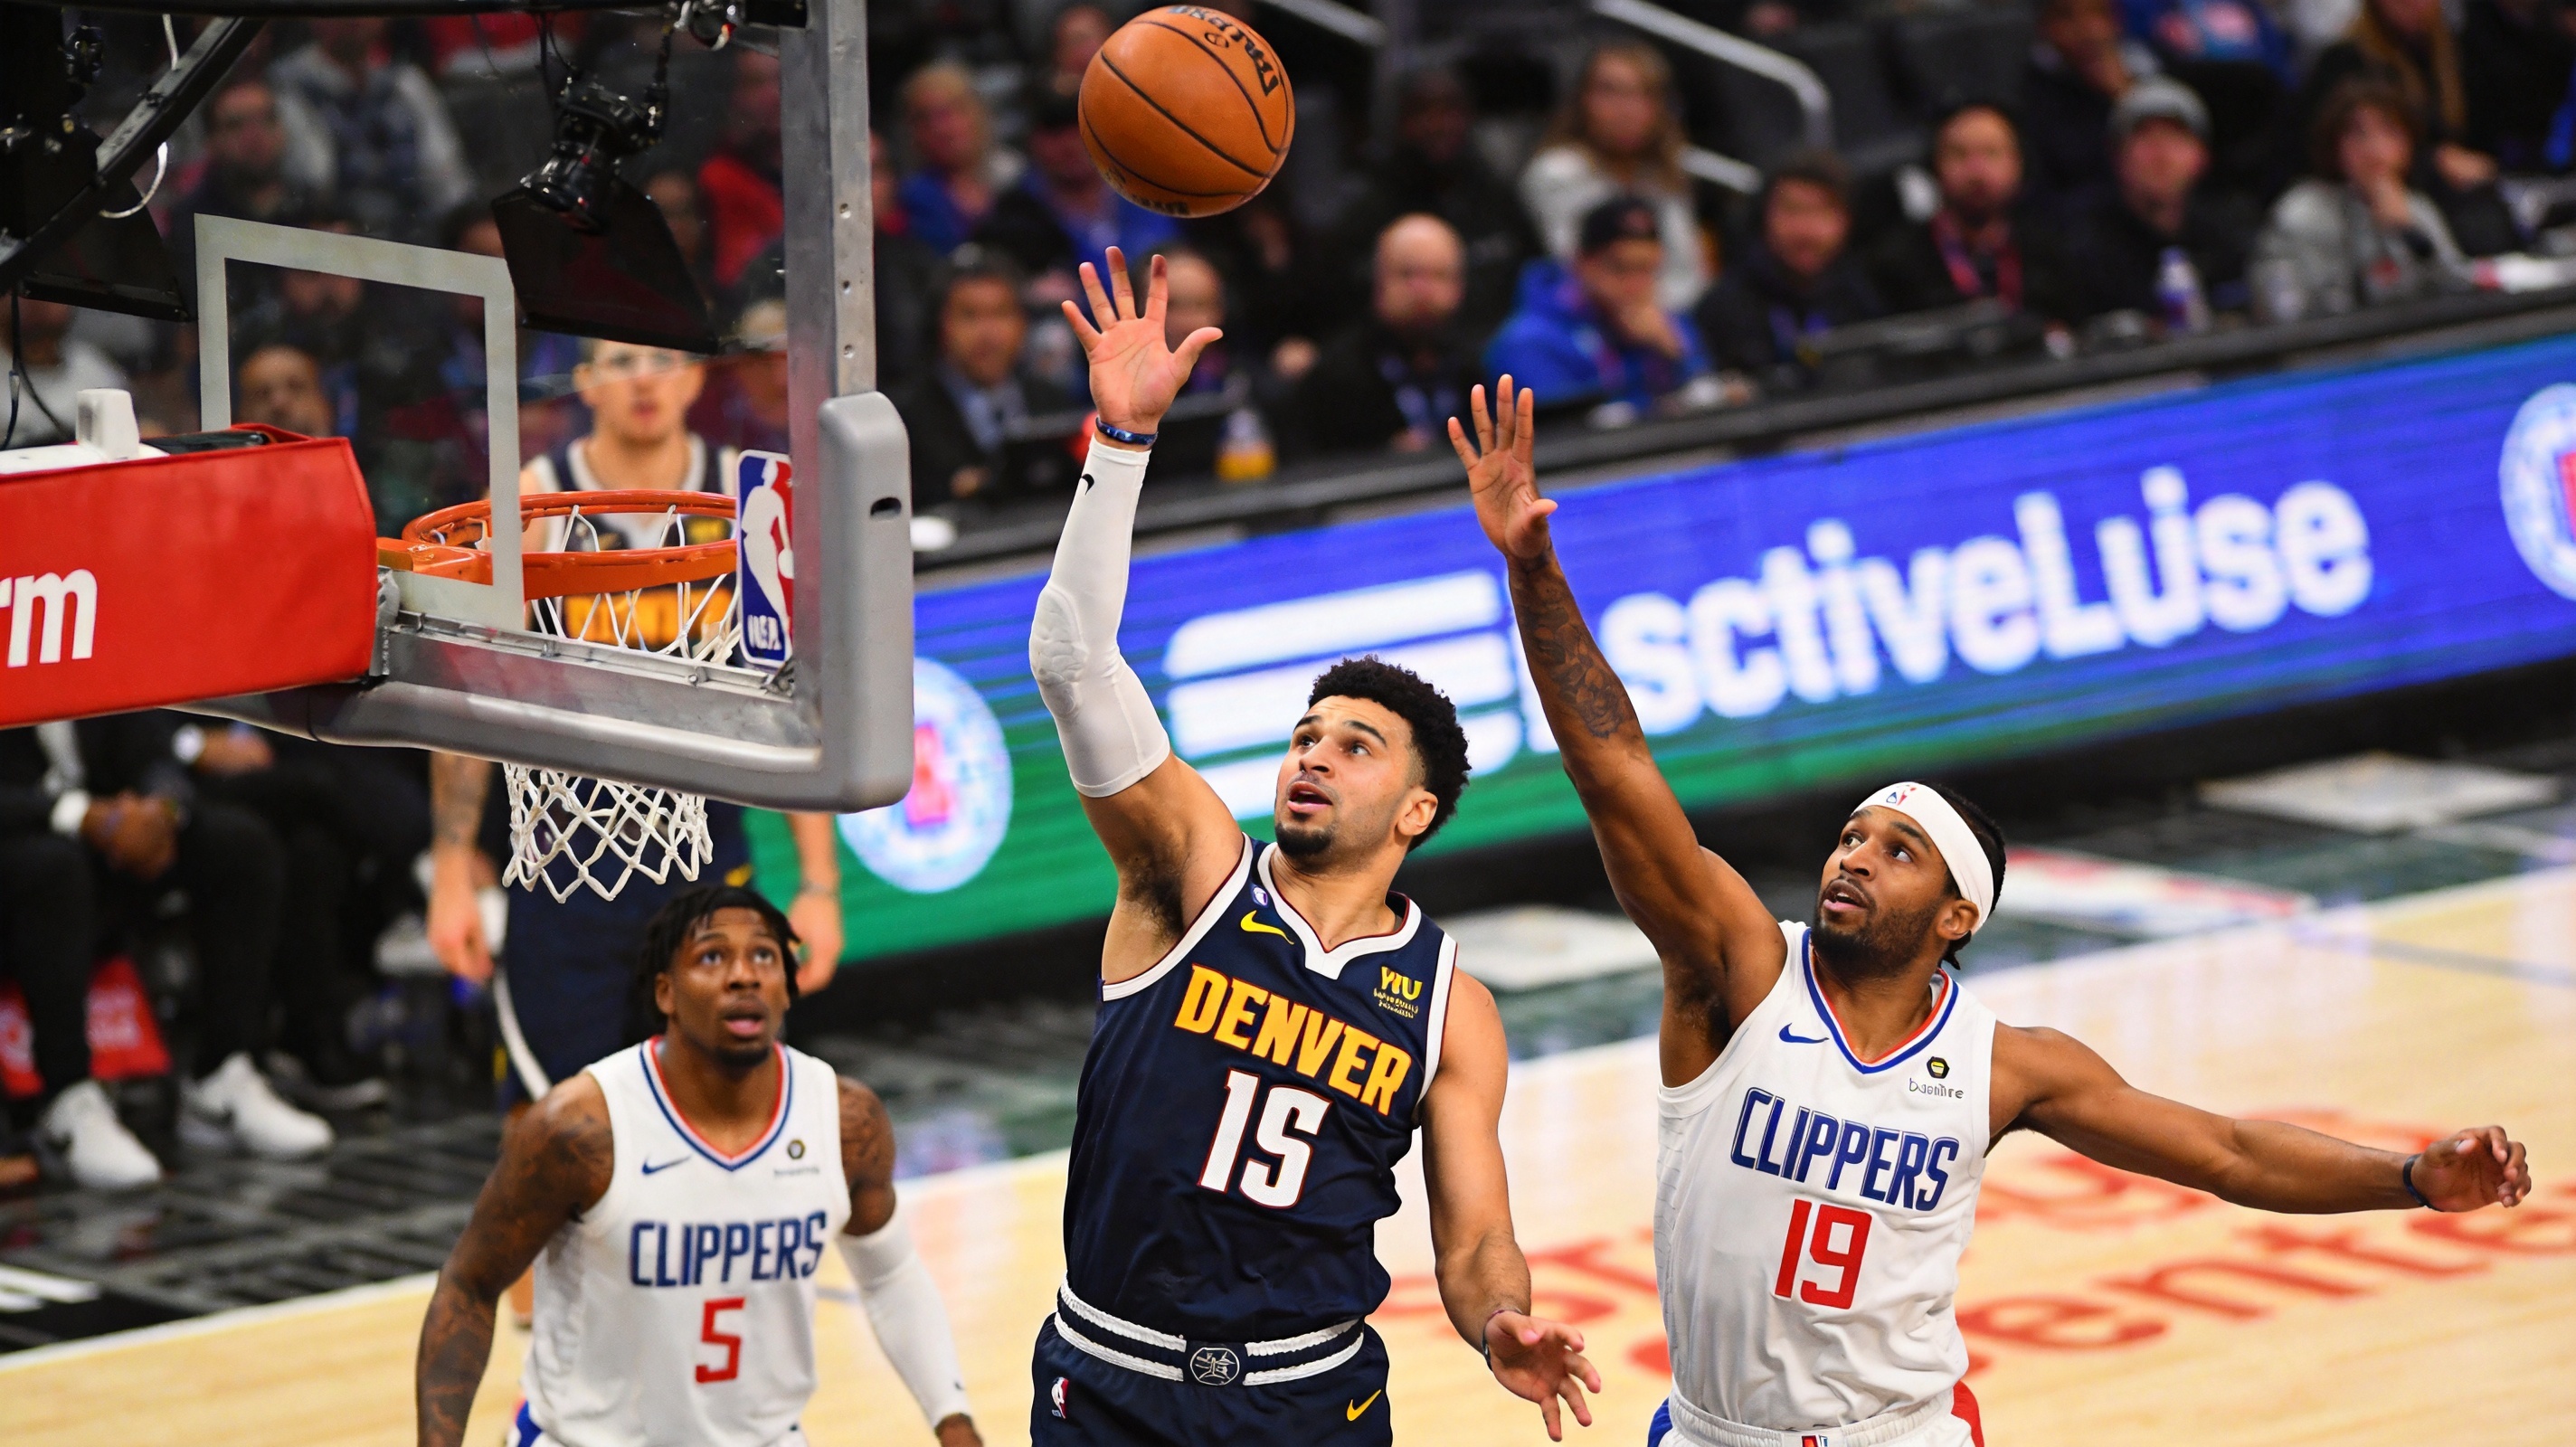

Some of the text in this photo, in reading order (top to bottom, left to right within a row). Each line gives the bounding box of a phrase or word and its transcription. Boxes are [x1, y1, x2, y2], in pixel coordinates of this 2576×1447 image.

[1174, 962, 1412, 1116] DENVER
[1197, 1067, 1333, 1209] 15
[1730, 1086, 1960, 1212] CLIPPERS
[630, 1209, 827, 1287] CLIPPERS
[1775, 1198, 1872, 1310] 19
[695, 1296, 746, 1385] 5
